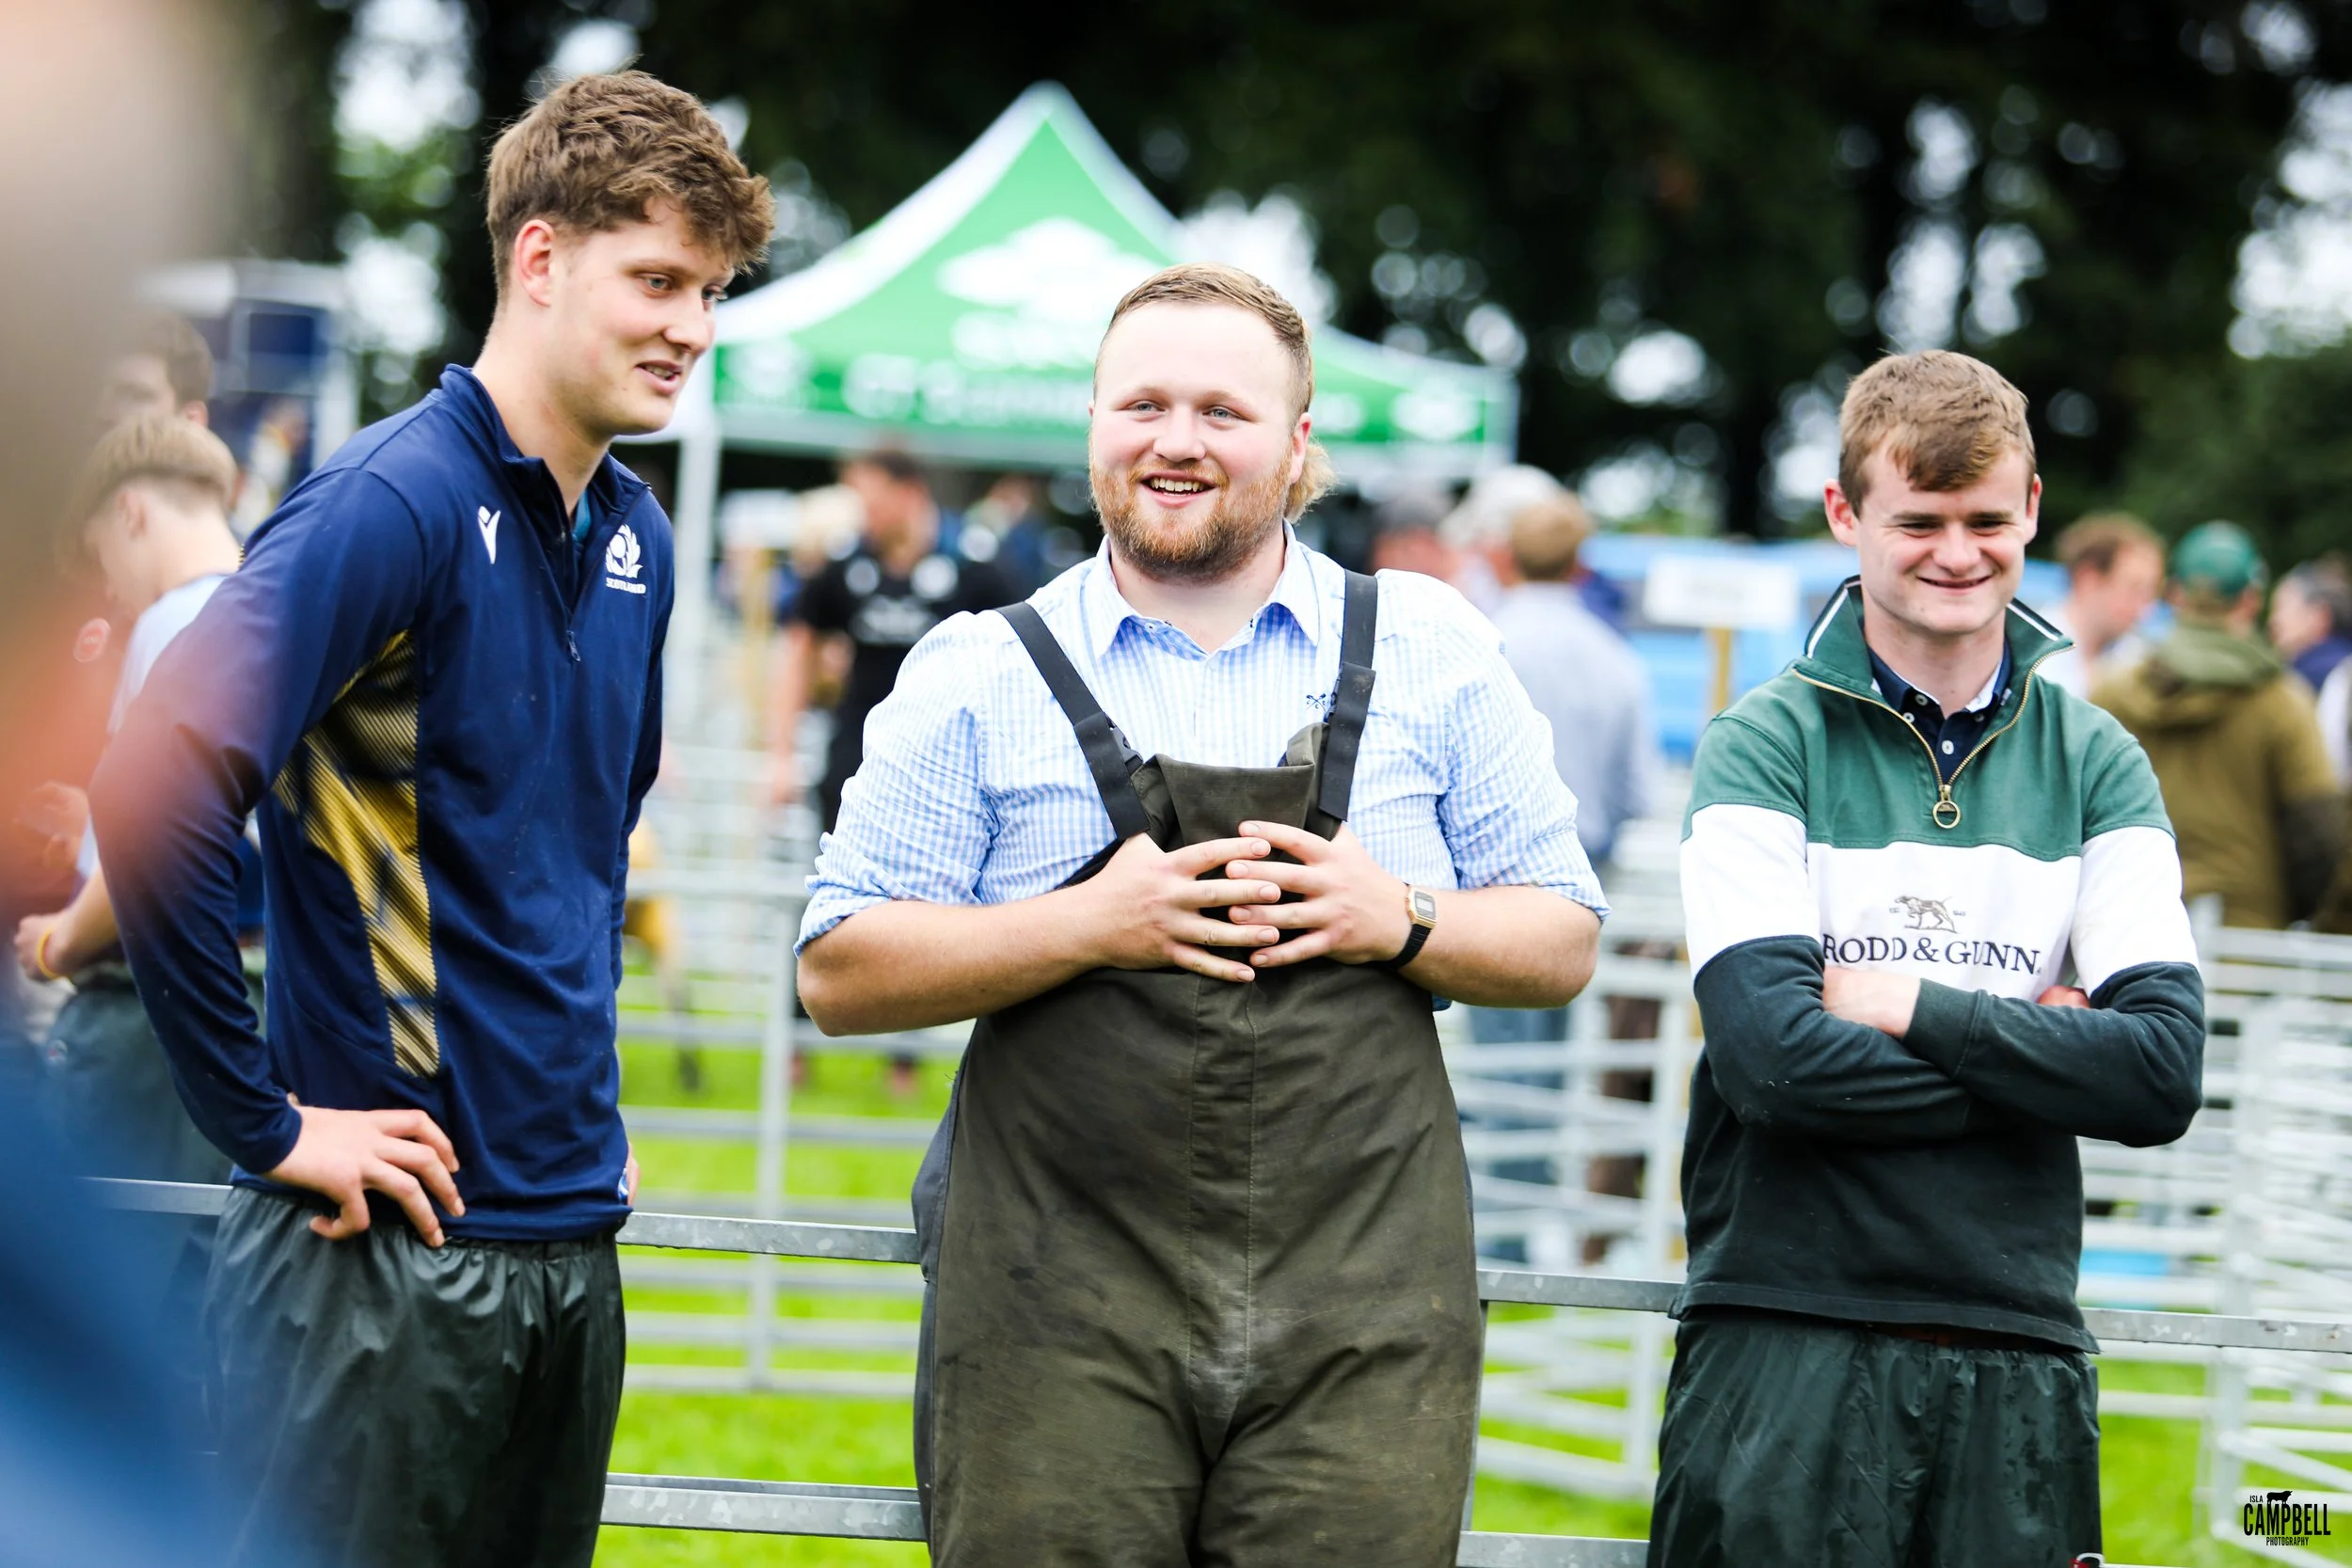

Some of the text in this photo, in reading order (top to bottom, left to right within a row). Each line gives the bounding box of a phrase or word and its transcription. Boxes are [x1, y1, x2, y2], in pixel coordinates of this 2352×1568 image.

[1822, 933, 2041, 974] RODD & GUNN
